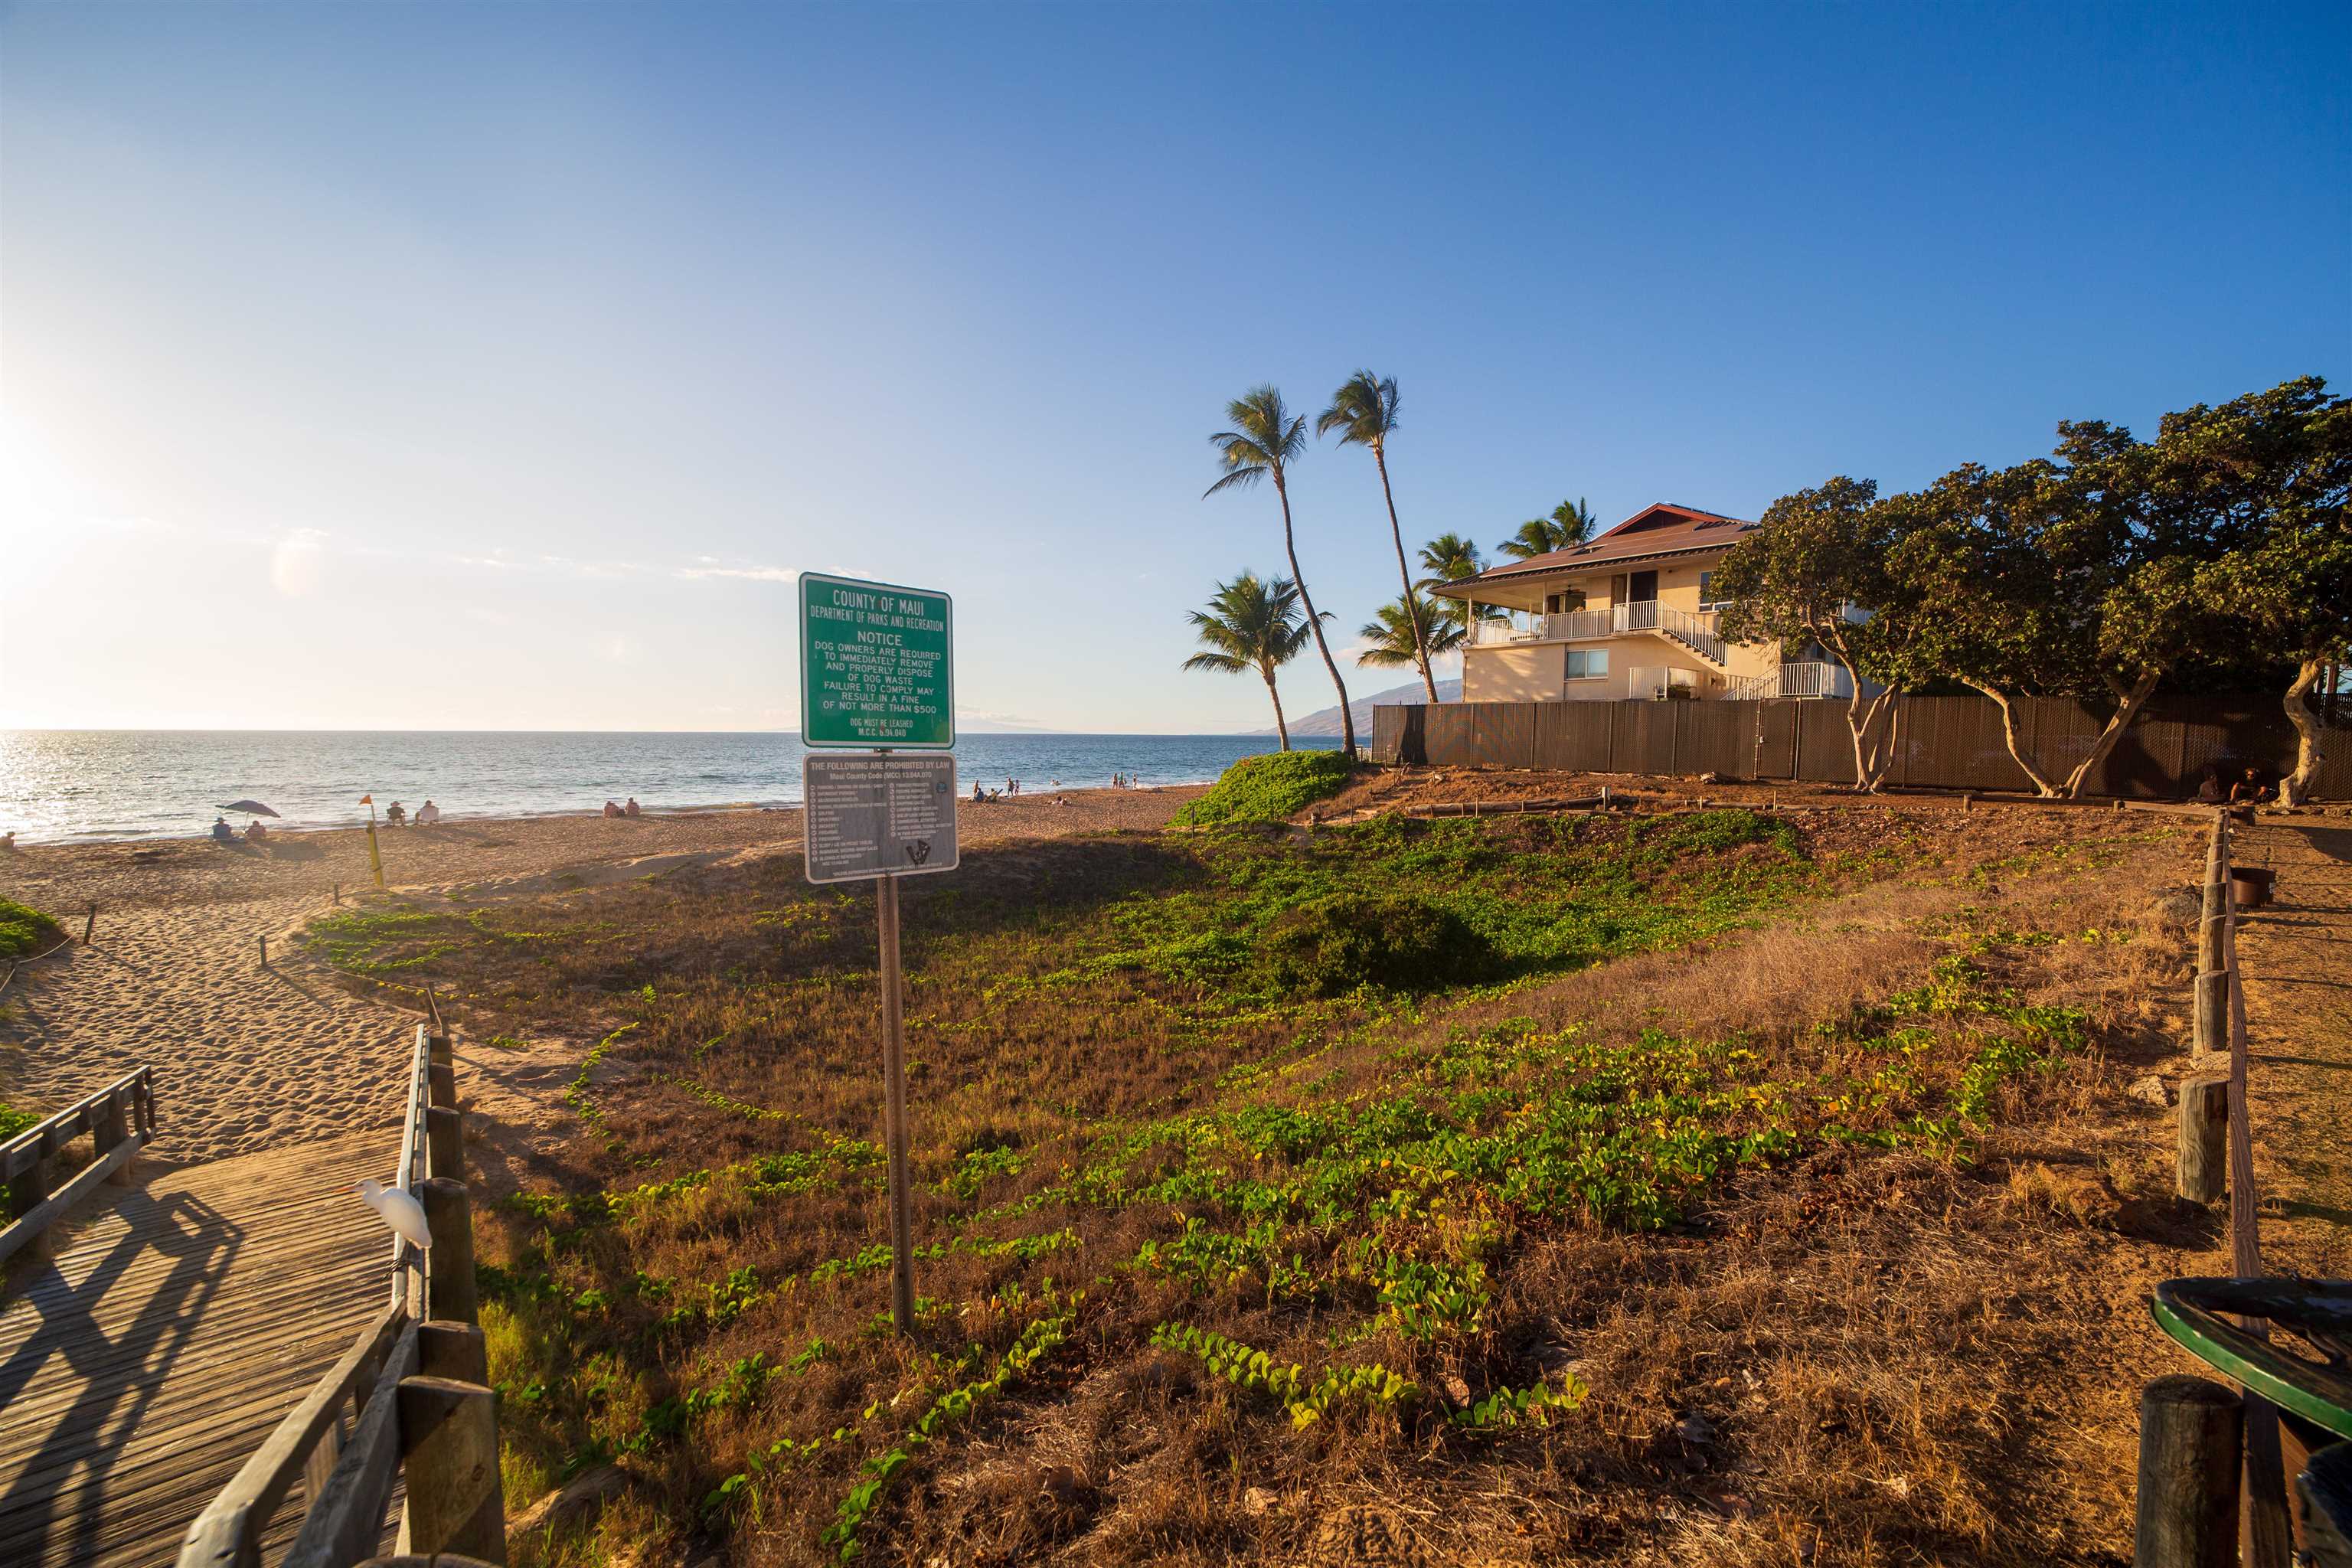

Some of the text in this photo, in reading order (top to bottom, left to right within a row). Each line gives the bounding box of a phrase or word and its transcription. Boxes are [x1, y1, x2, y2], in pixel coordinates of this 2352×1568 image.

[833, 590, 923, 616] COUNTY OF MAUI
[811, 606, 943, 632] DEPARTMENT OF PARKS AND RECREATION
[858, 631, 902, 646] NOTICE
[815, 642, 833, 650] DOG
[838, 644, 874, 655] OWNERS
[900, 650, 941, 660] REQUIRED
[840, 654, 897, 665] IMMEDIATELY
[900, 659, 934, 668] REMOVE
[826, 662, 933, 677] AND PROPERLY DISPOSE
[824, 681, 861, 691] FAILURE
[880, 685, 913, 694] COMPLY
[885, 677, 913, 685] WASTE
[841, 693, 874, 701] RESULT
[822, 701, 835, 709] OF
